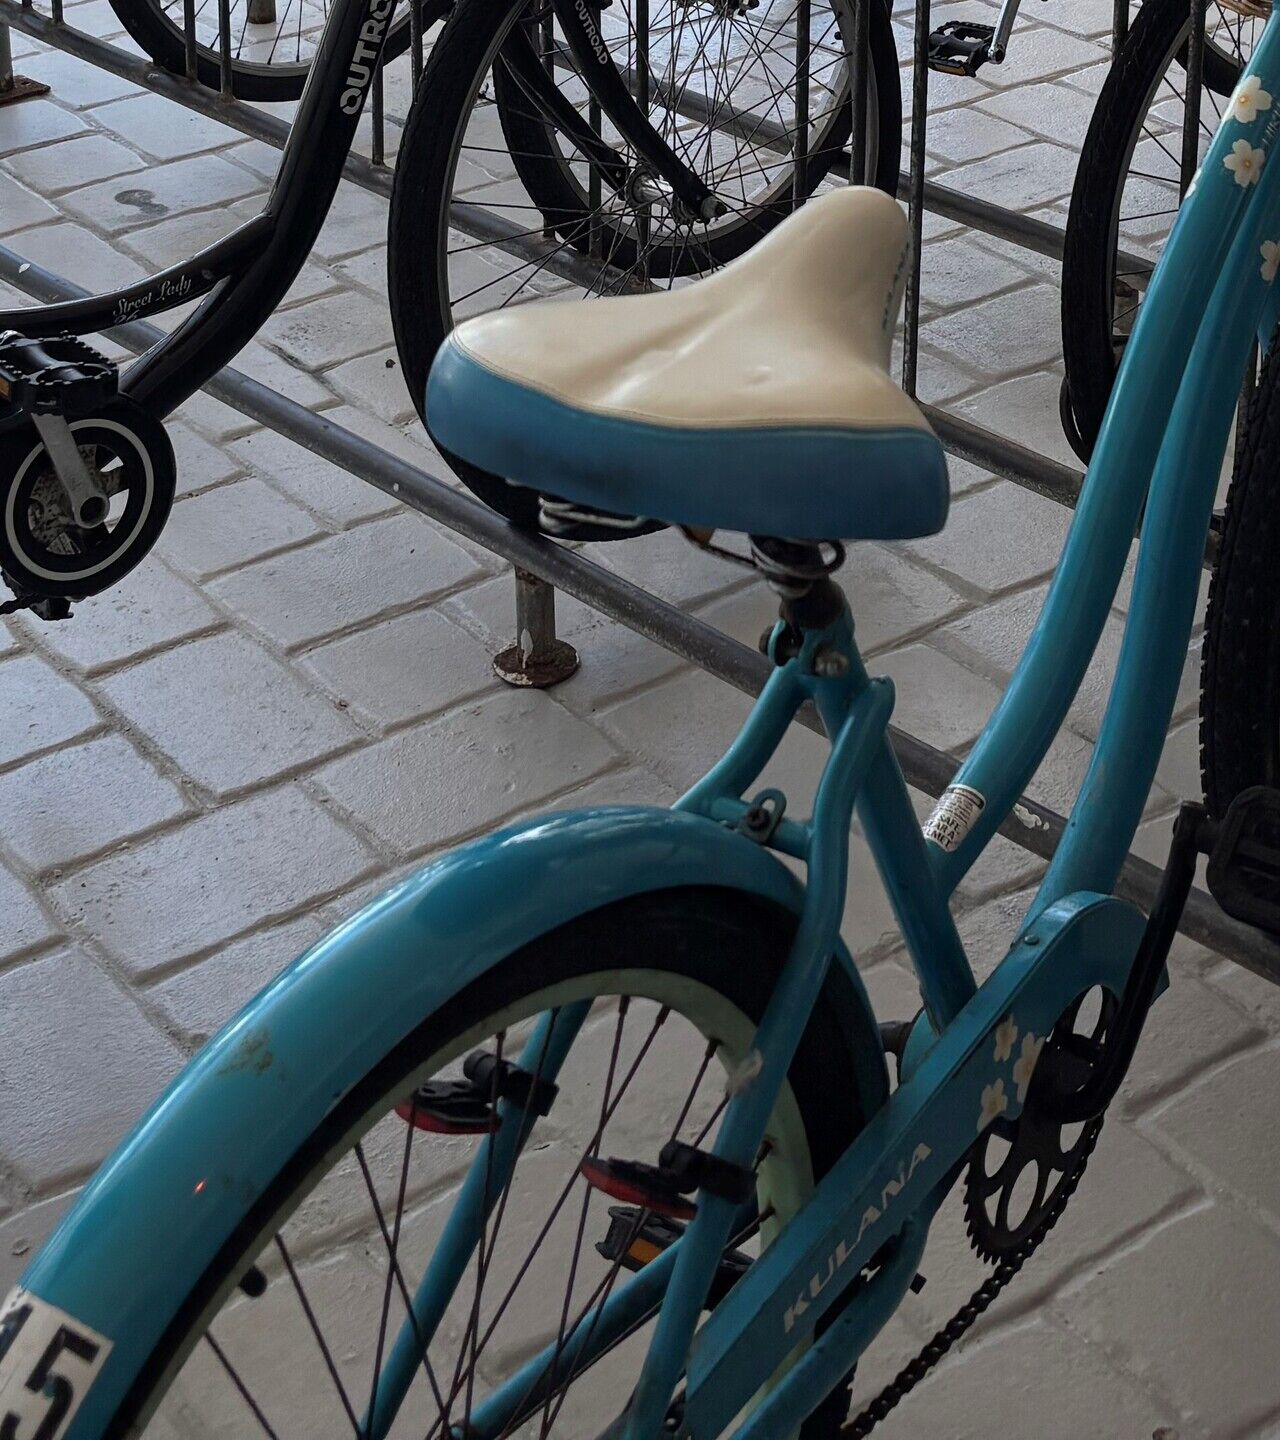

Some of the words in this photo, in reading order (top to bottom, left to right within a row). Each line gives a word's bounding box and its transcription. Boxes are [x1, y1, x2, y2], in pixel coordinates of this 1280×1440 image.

[575, 0, 608, 65] OUTROAD
[113, 291, 152, 316] Street
[156, 274, 192, 300] Lady
[783, 1142, 932, 1334] KULANA
